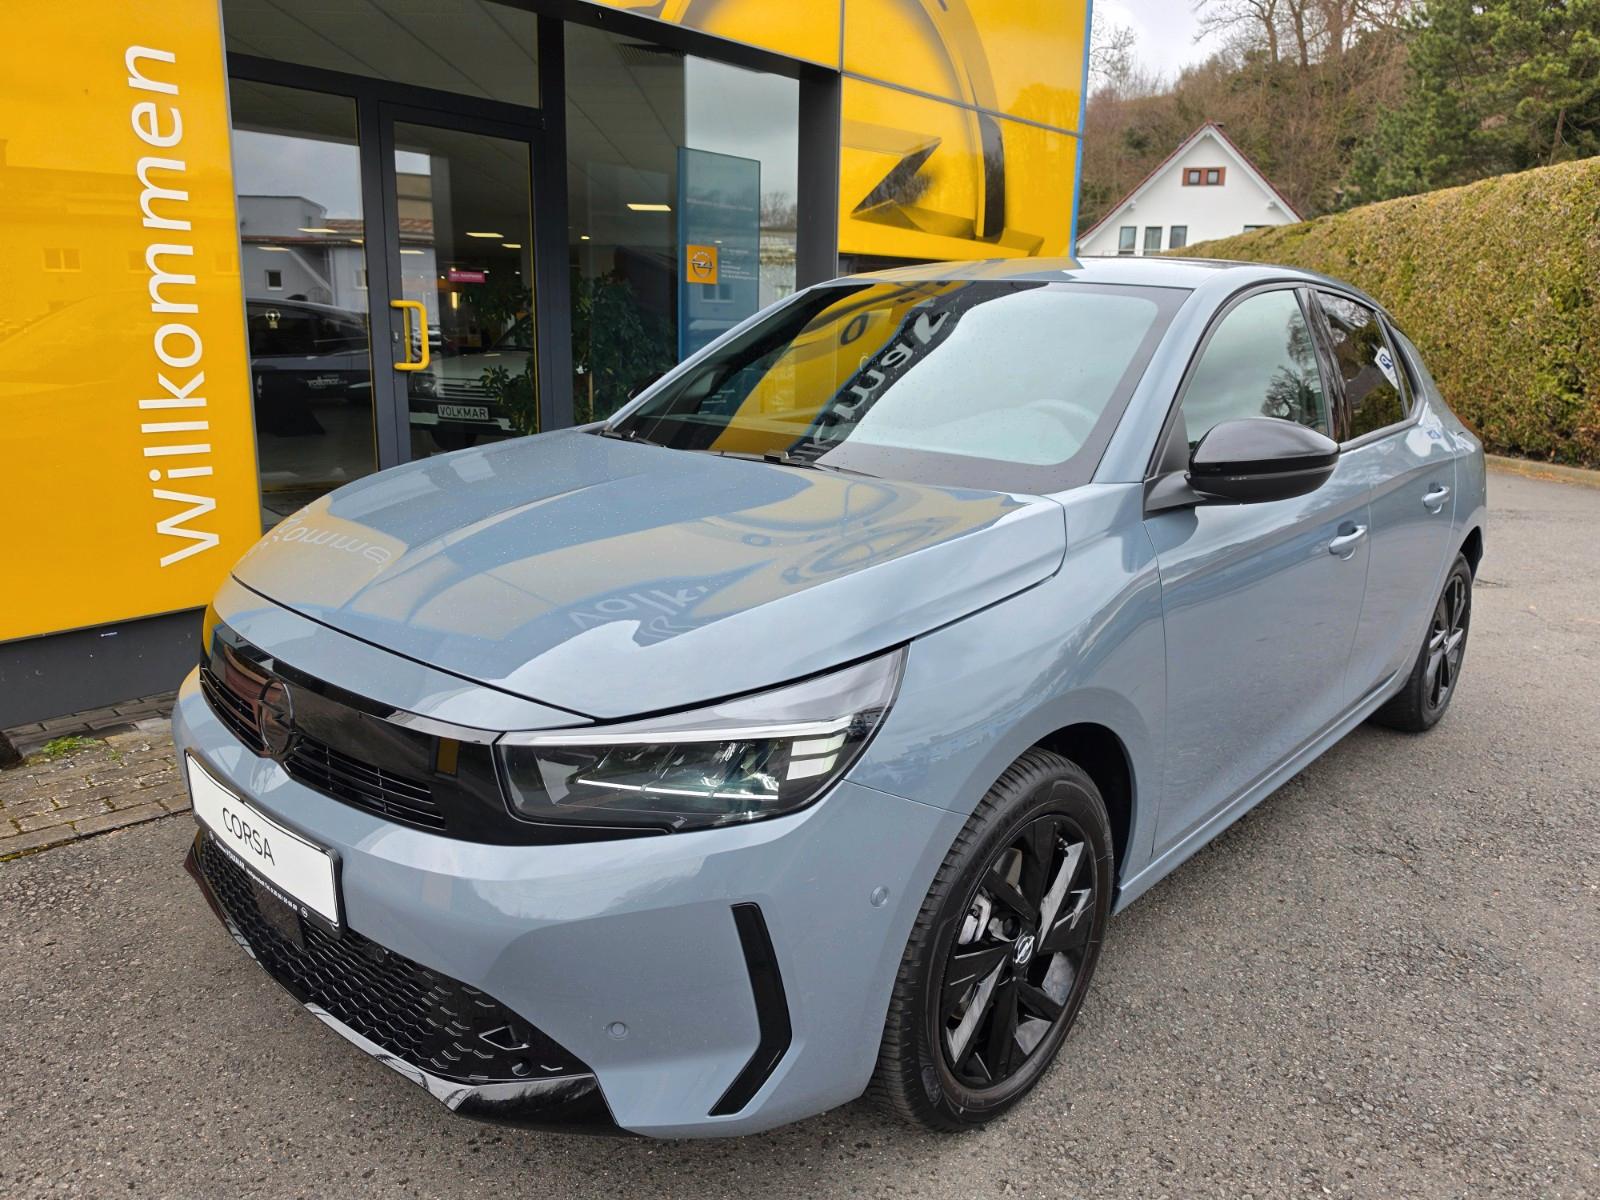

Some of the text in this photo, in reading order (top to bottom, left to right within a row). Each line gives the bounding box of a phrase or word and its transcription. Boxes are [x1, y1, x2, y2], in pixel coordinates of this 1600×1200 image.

[125, 45, 220, 567] Willkommen
[439, 406, 487, 418] VOLKMAR
[222, 807, 275, 866] CORSA
